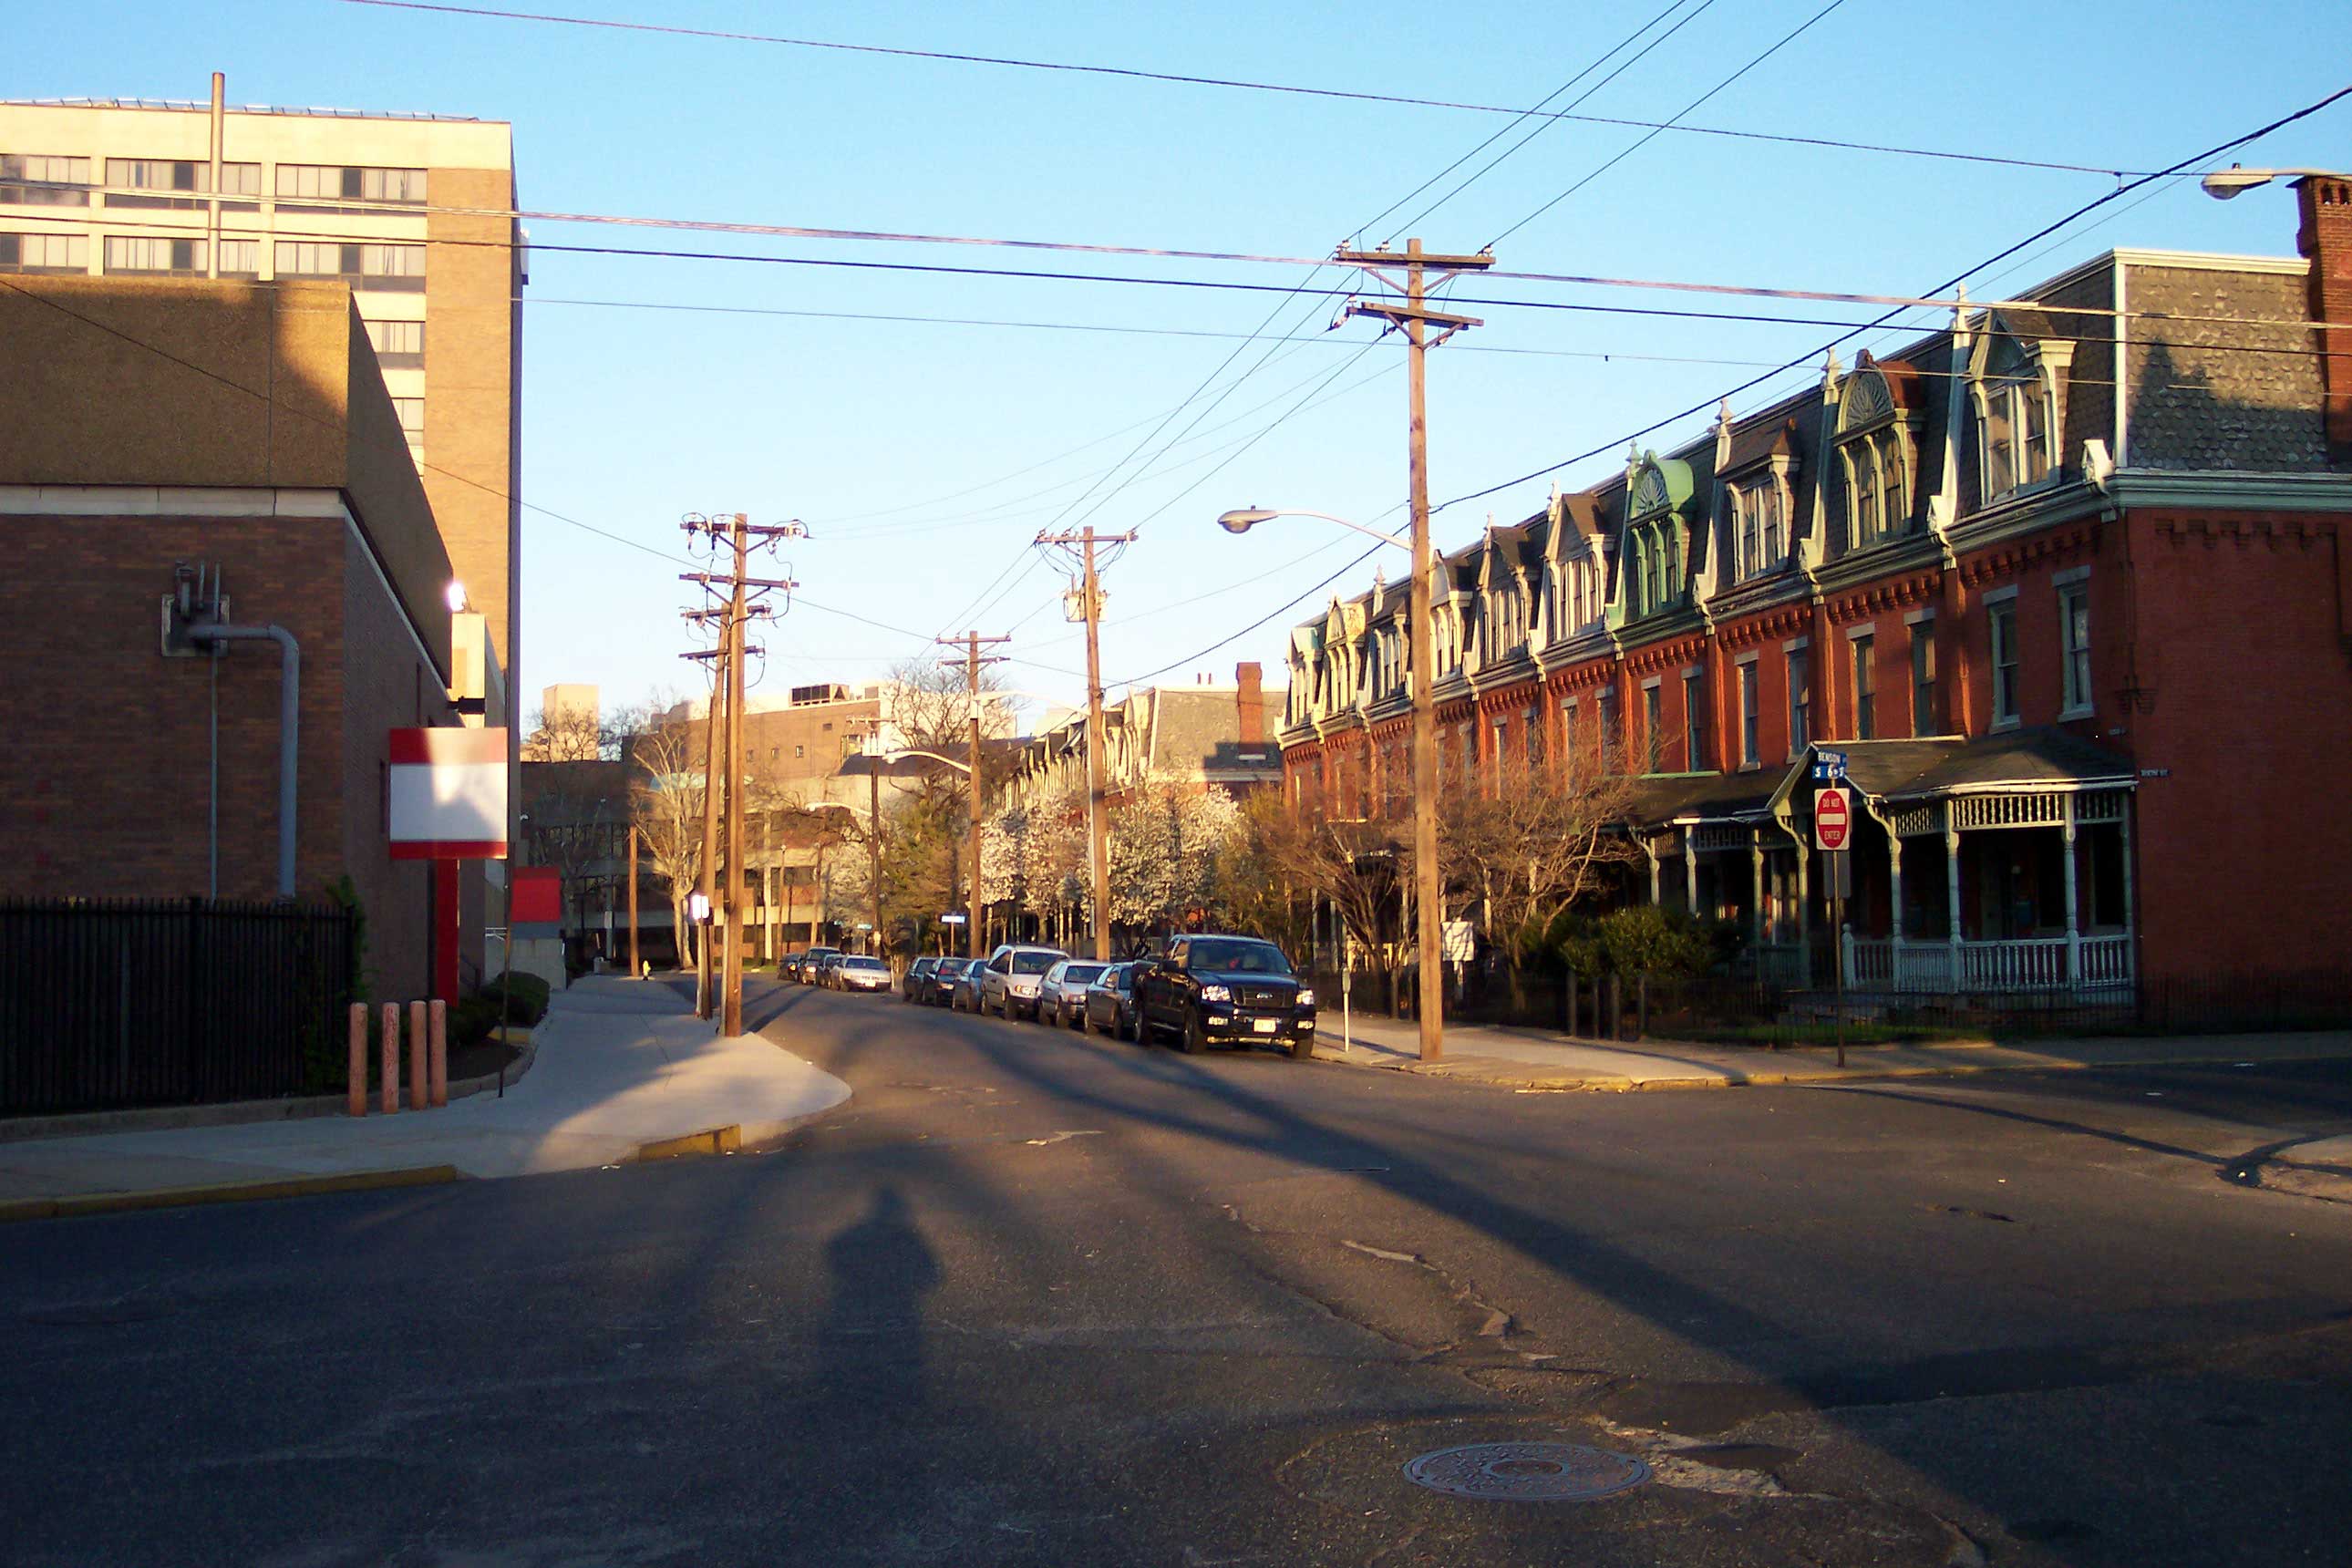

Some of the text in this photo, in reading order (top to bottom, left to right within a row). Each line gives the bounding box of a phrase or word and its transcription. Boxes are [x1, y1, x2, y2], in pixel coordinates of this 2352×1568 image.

[1815, 767, 1821, 778] S
[1822, 797, 1841, 809] DO NOT
[1824, 830, 1841, 841] ENTER
